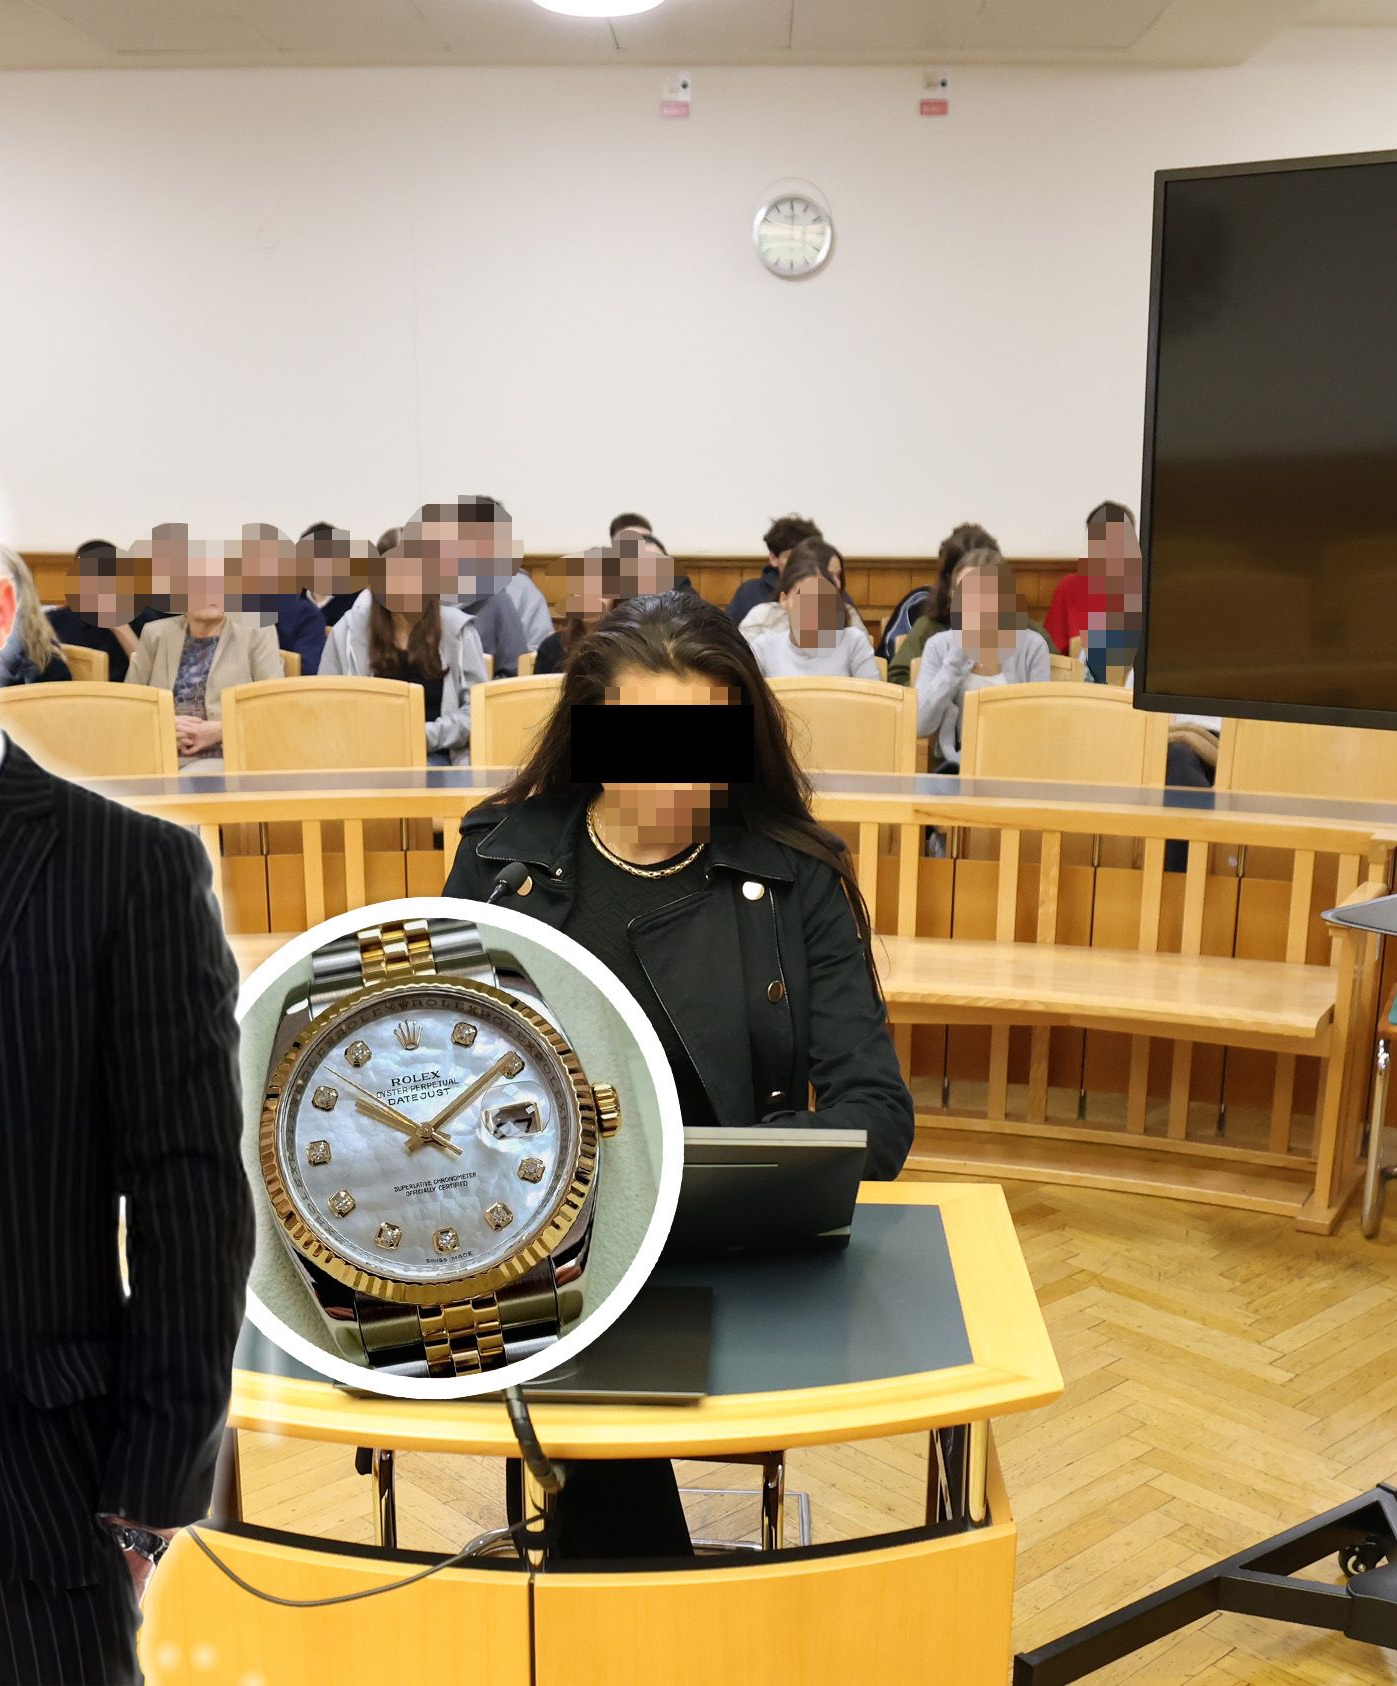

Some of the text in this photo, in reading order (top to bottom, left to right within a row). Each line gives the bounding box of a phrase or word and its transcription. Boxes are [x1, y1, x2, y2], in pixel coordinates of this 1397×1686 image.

[376, 1077, 459, 1098] OYSTER PERPETUAL
[391, 1071, 440, 1087] ROLEX
[388, 1087, 451, 1106] DATEJUST
[394, 1171, 477, 1193] SUPERLATIVE CHRONOMETER
[405, 1180, 468, 1197] OFFICIALLY CERTIFIED
[451, 1250, 473, 1260] MADE
